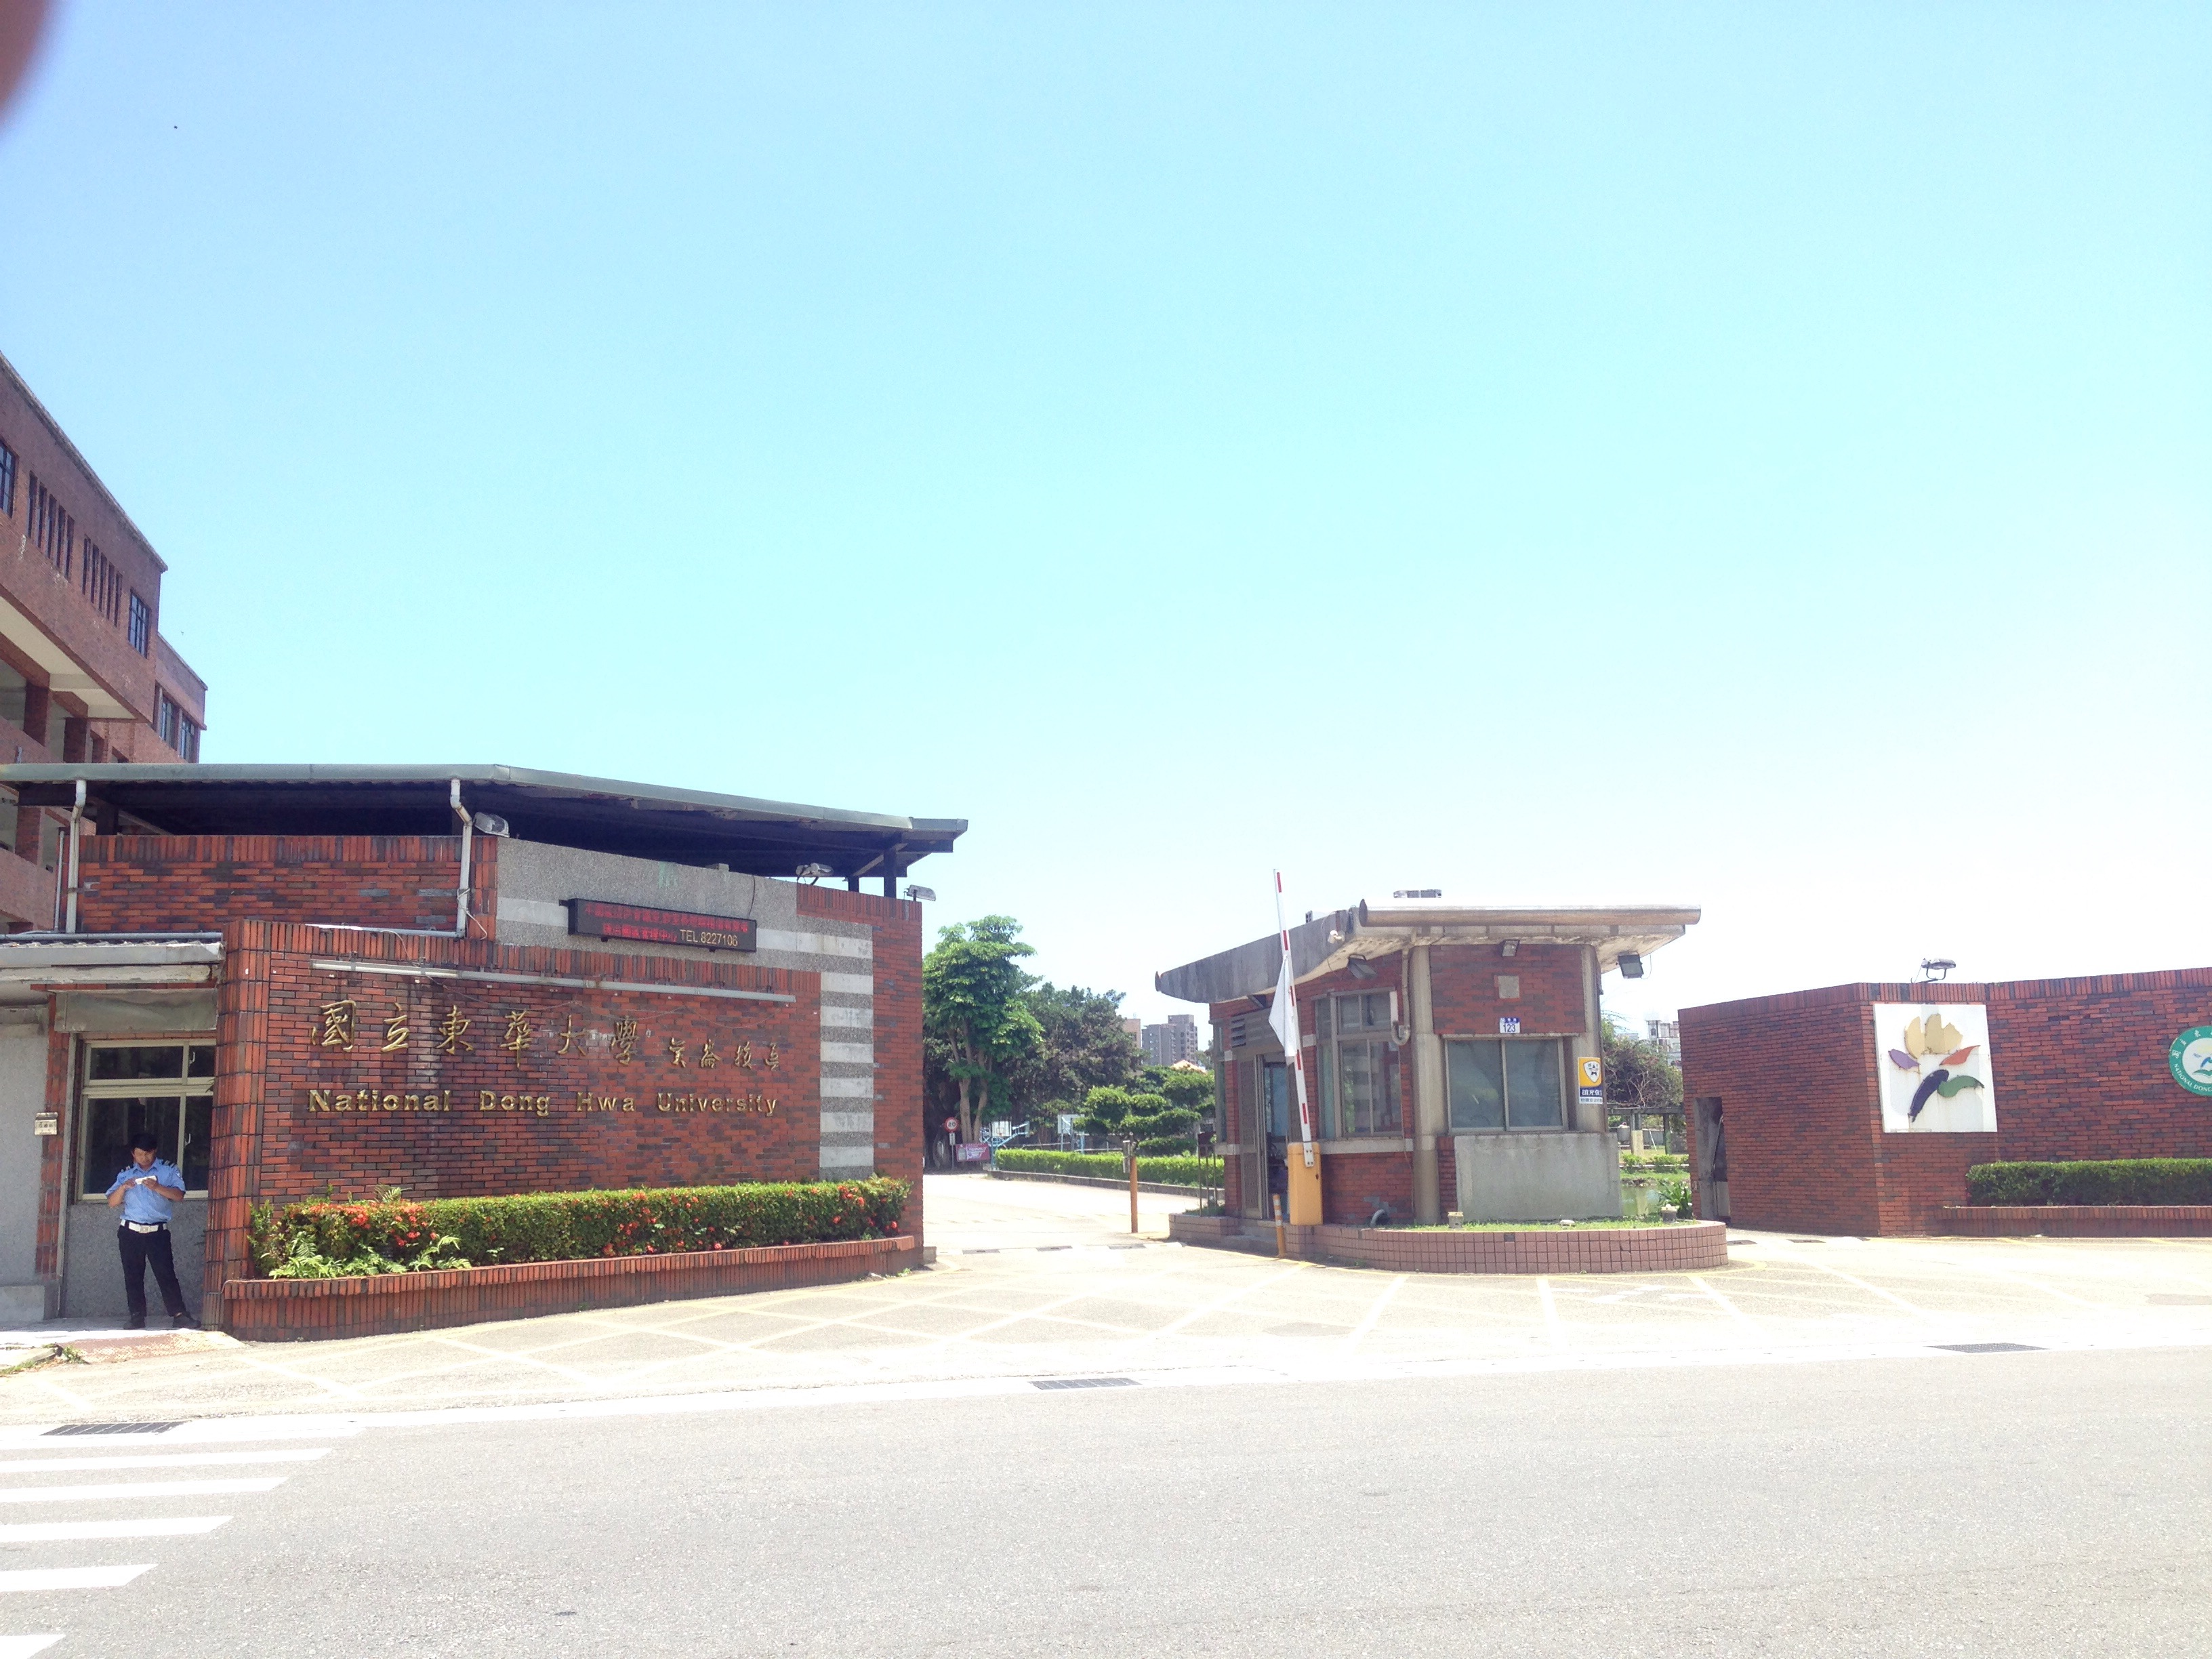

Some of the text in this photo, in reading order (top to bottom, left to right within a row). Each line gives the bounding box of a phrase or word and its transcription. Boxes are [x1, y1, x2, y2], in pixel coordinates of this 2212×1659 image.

[1503, 1023, 1516, 1033] 123
[308, 1089, 778, 1118] National Dong Hwa University
